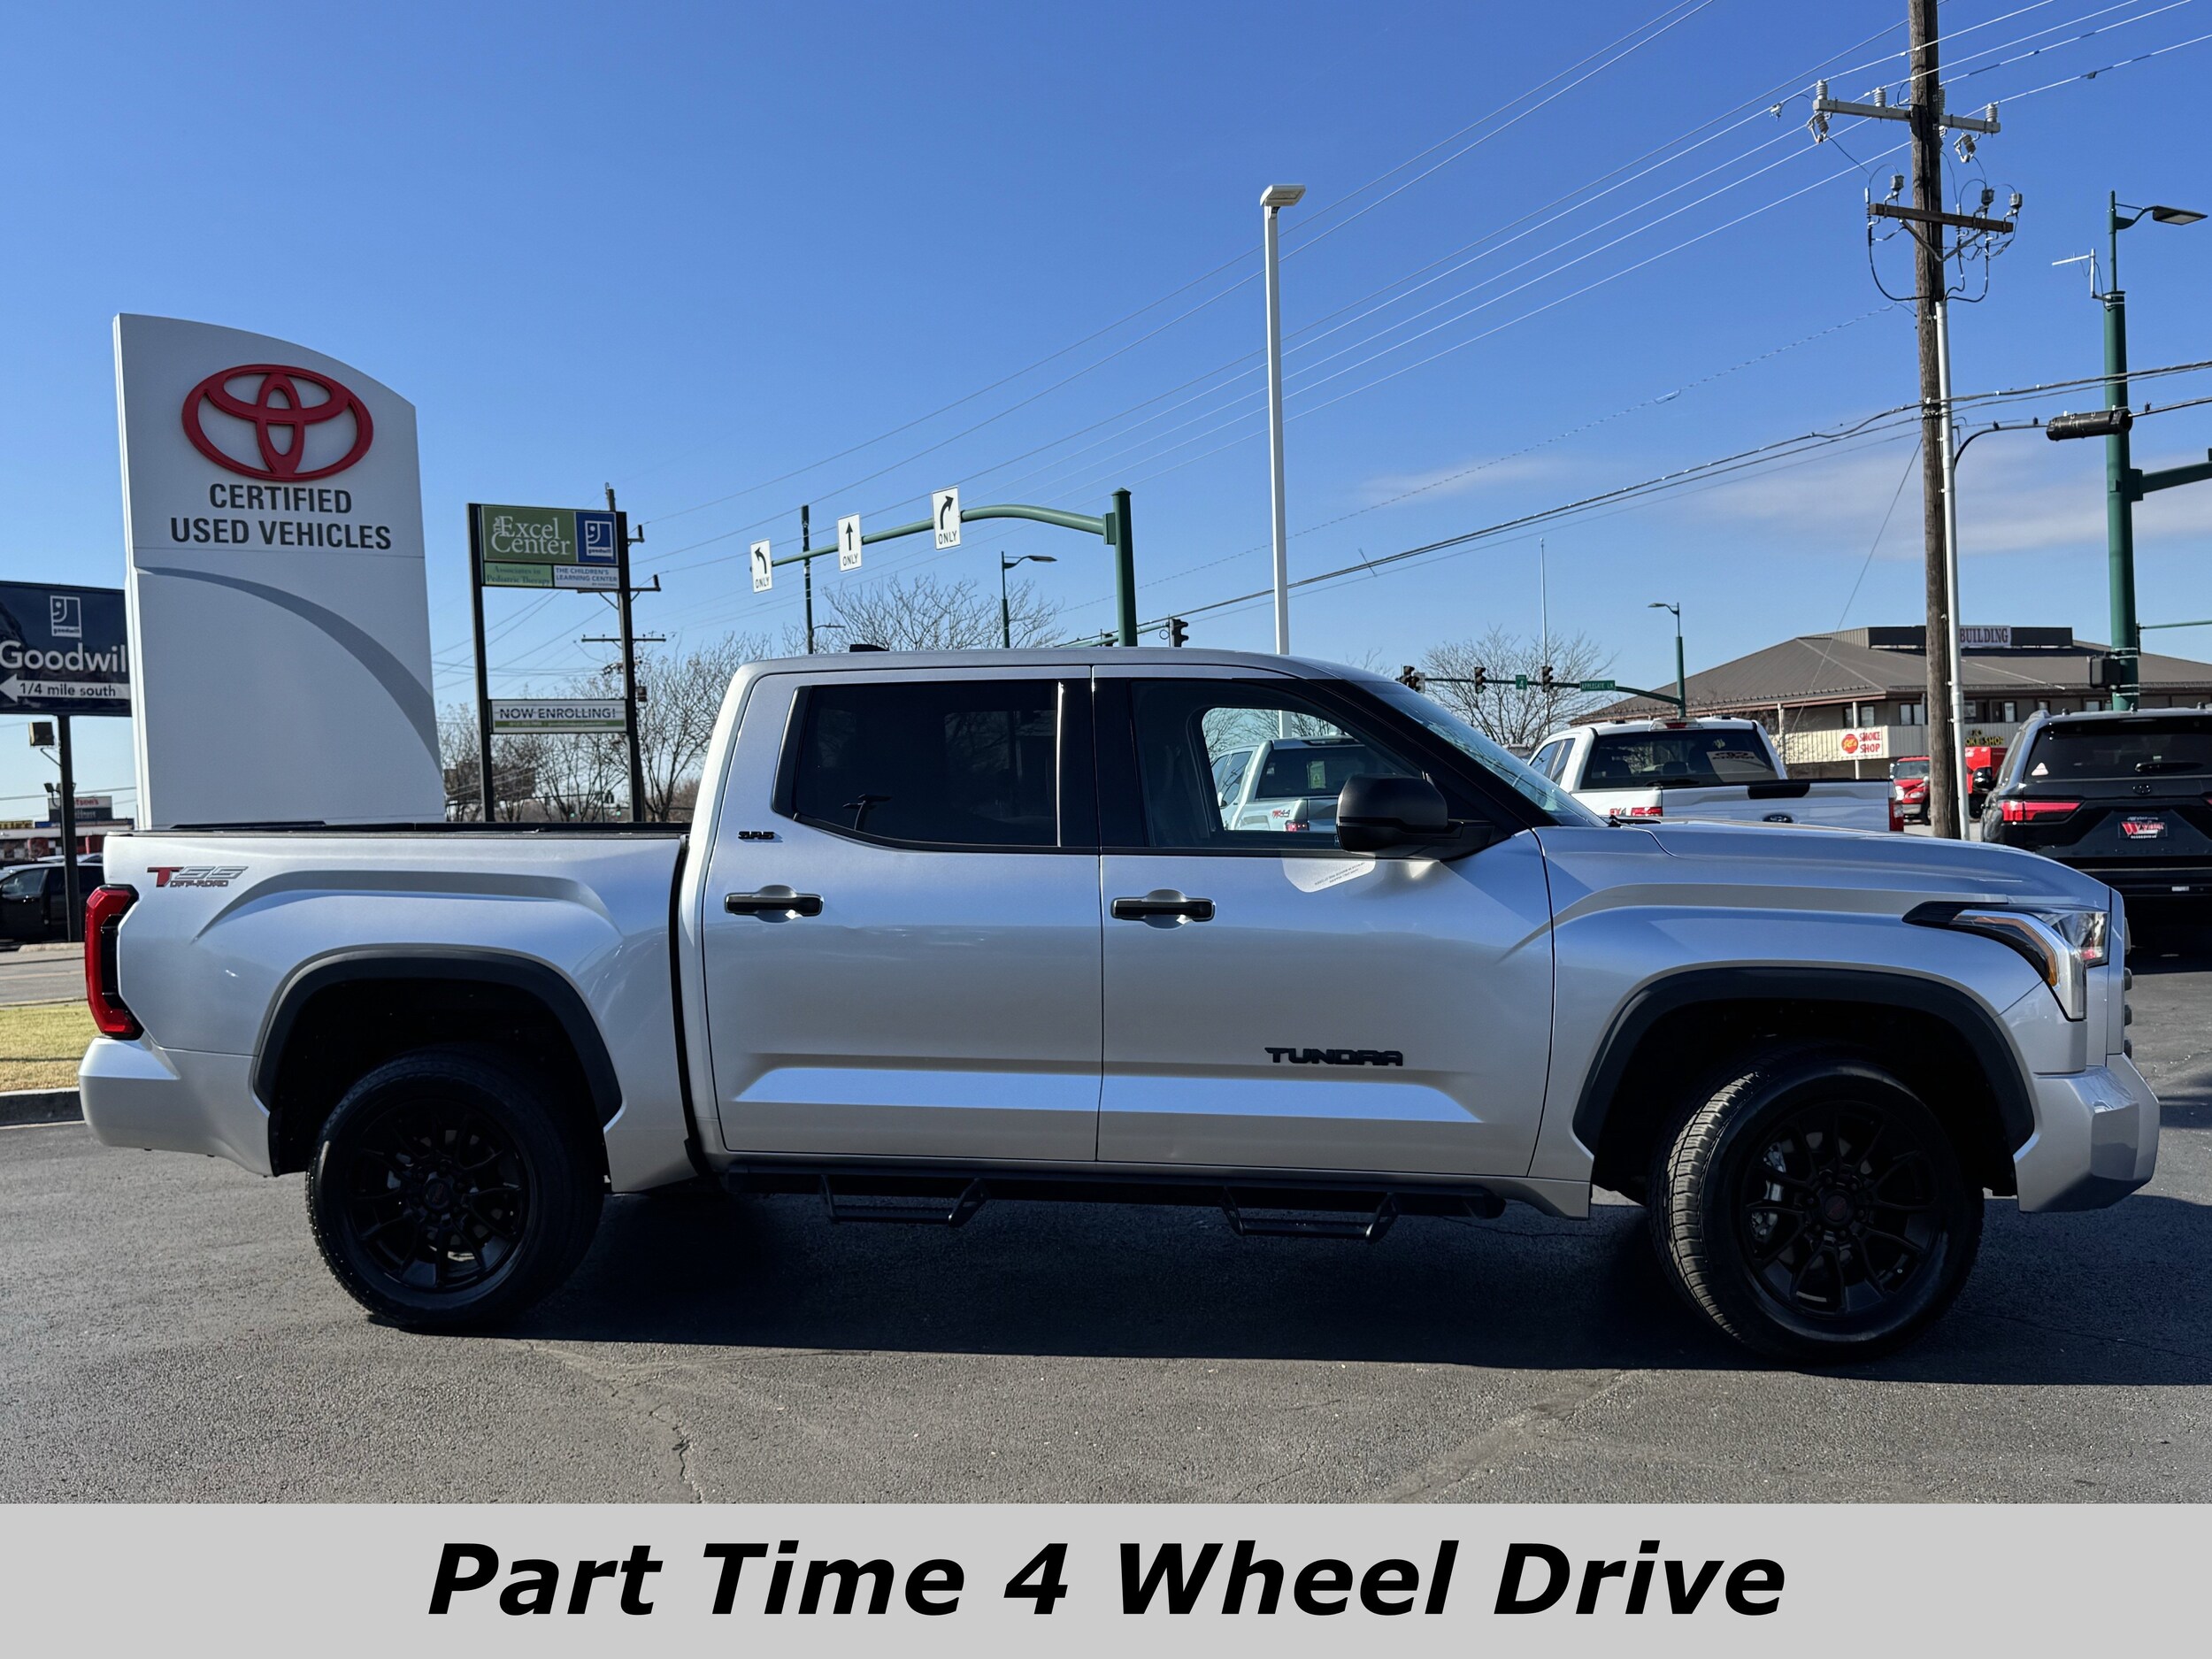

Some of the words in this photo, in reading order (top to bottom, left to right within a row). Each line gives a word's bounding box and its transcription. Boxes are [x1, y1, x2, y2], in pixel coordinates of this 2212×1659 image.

[210, 483, 352, 513] CERTIFIED
[171, 518, 250, 543] USED
[258, 520, 392, 549] VEHICLES
[499, 515, 560, 540] Excel
[491, 532, 571, 556] Center
[938, 530, 957, 545] ONLY
[842, 553, 858, 566] ONLY
[755, 577, 770, 588] ONLY
[1960, 627, 2008, 643] BUILDING
[0, 640, 126, 672] Goodwil
[19, 682, 42, 695] 1/4
[48, 683, 75, 696] mile
[80, 685, 116, 697] south
[500, 709, 534, 718] NOW
[538, 708, 616, 718] ENROLLING!
[1859, 732, 1880, 742] SMOKE
[1860, 743, 1880, 753] SHOP
[147, 866, 249, 887] TSS
[1264, 1047, 1404, 1066] TUNDRA
